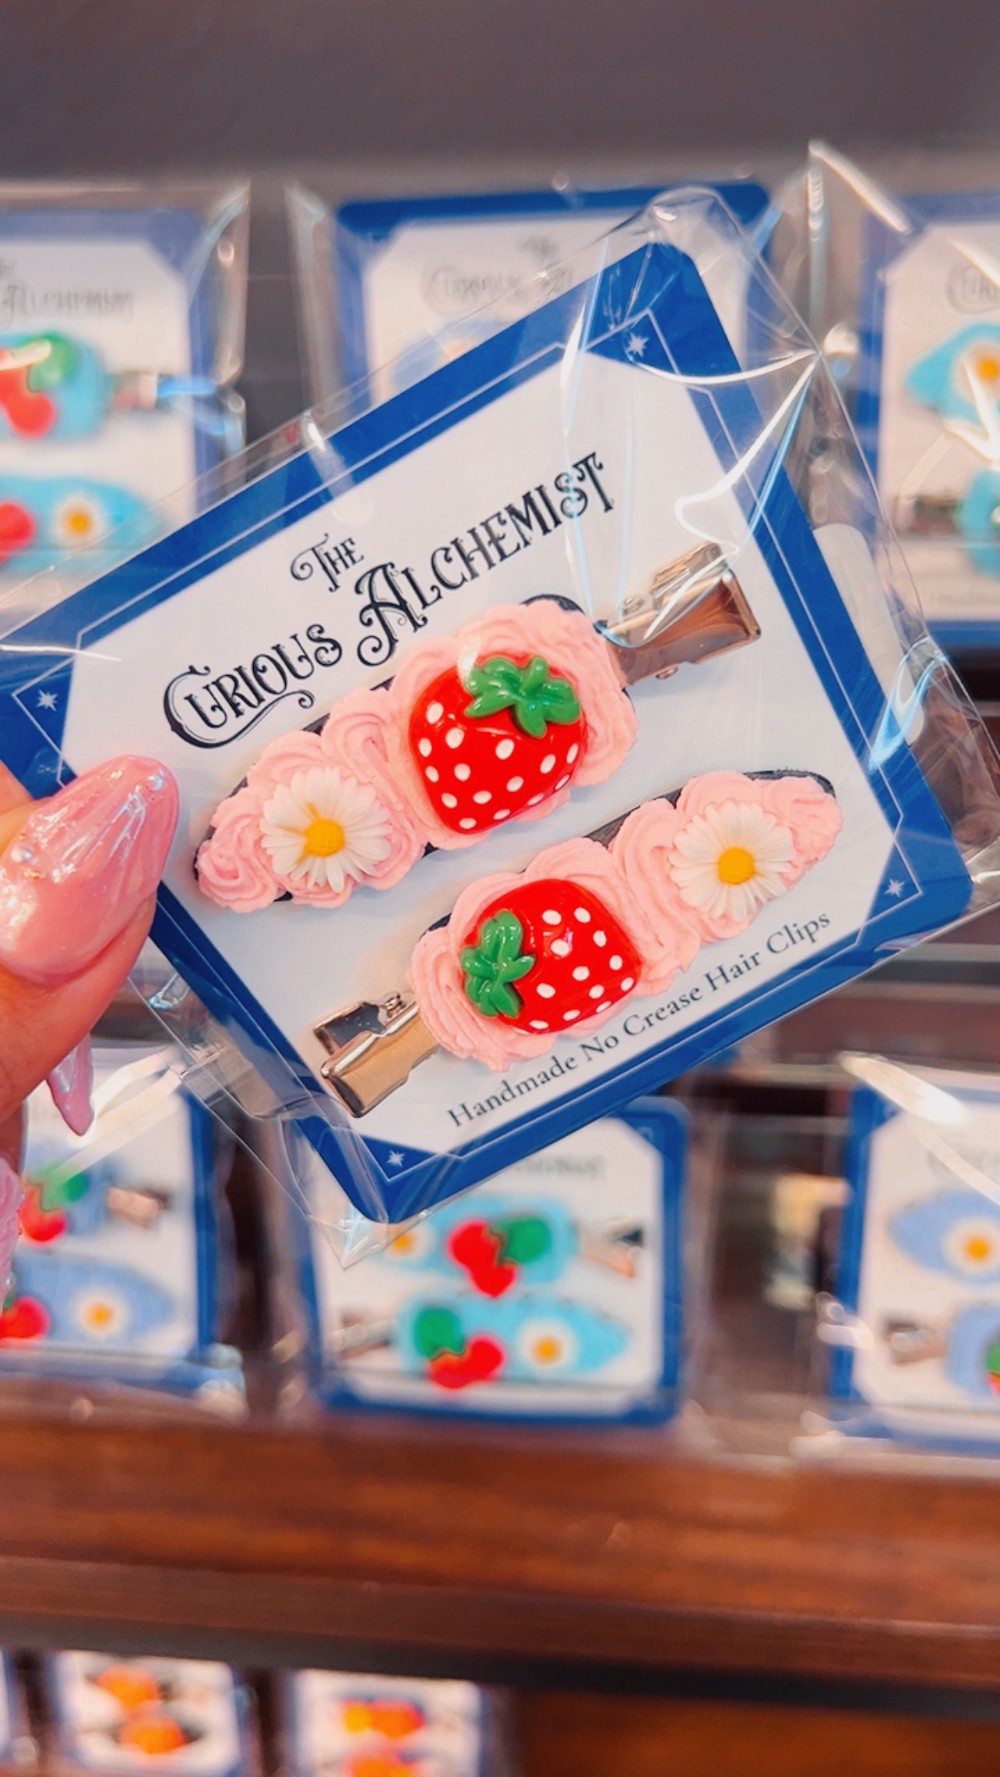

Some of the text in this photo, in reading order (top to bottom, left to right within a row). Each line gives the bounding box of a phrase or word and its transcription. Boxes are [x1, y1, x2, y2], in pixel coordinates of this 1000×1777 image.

[163, 452, 615, 749] CURIOUS ALCHEMIST
[446, 911, 831, 1127] Handmade No Crease Hair Clips
